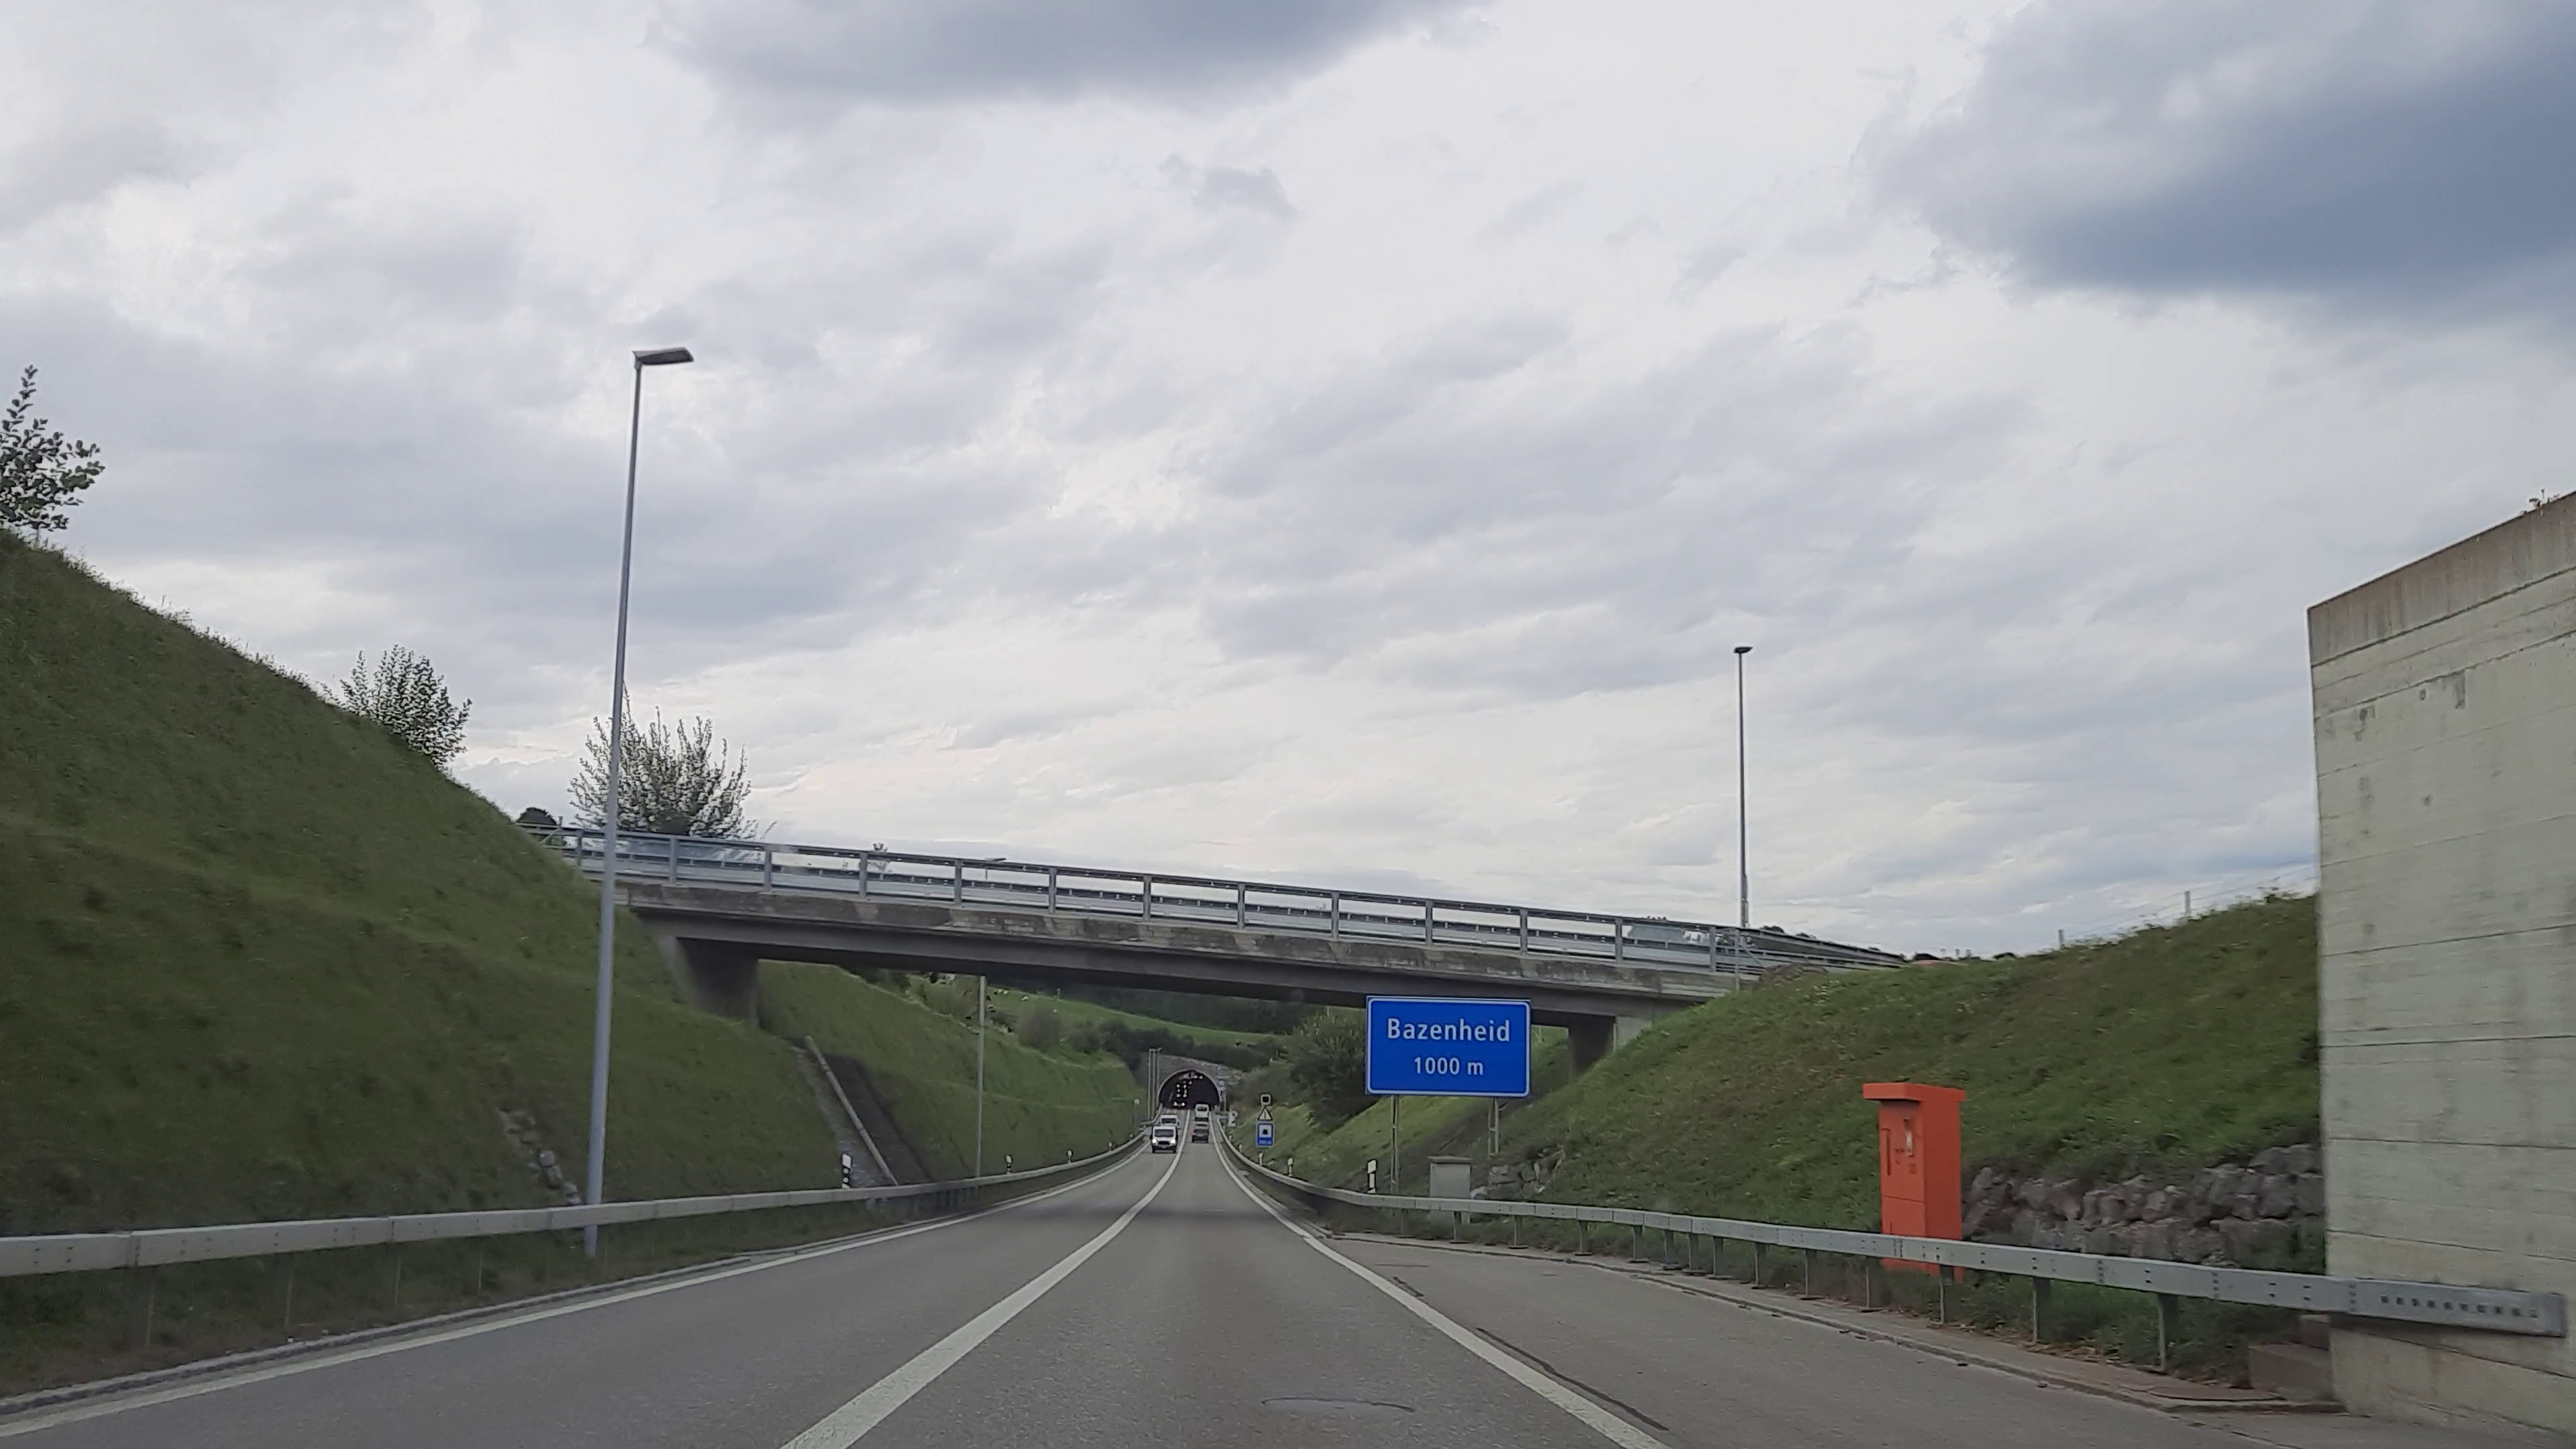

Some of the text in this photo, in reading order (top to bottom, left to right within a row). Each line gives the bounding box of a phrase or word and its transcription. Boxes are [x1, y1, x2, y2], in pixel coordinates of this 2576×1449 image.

[1387, 1018, 1510, 1042] Bazenheid
[1414, 1057, 1483, 1075] 1000 m
